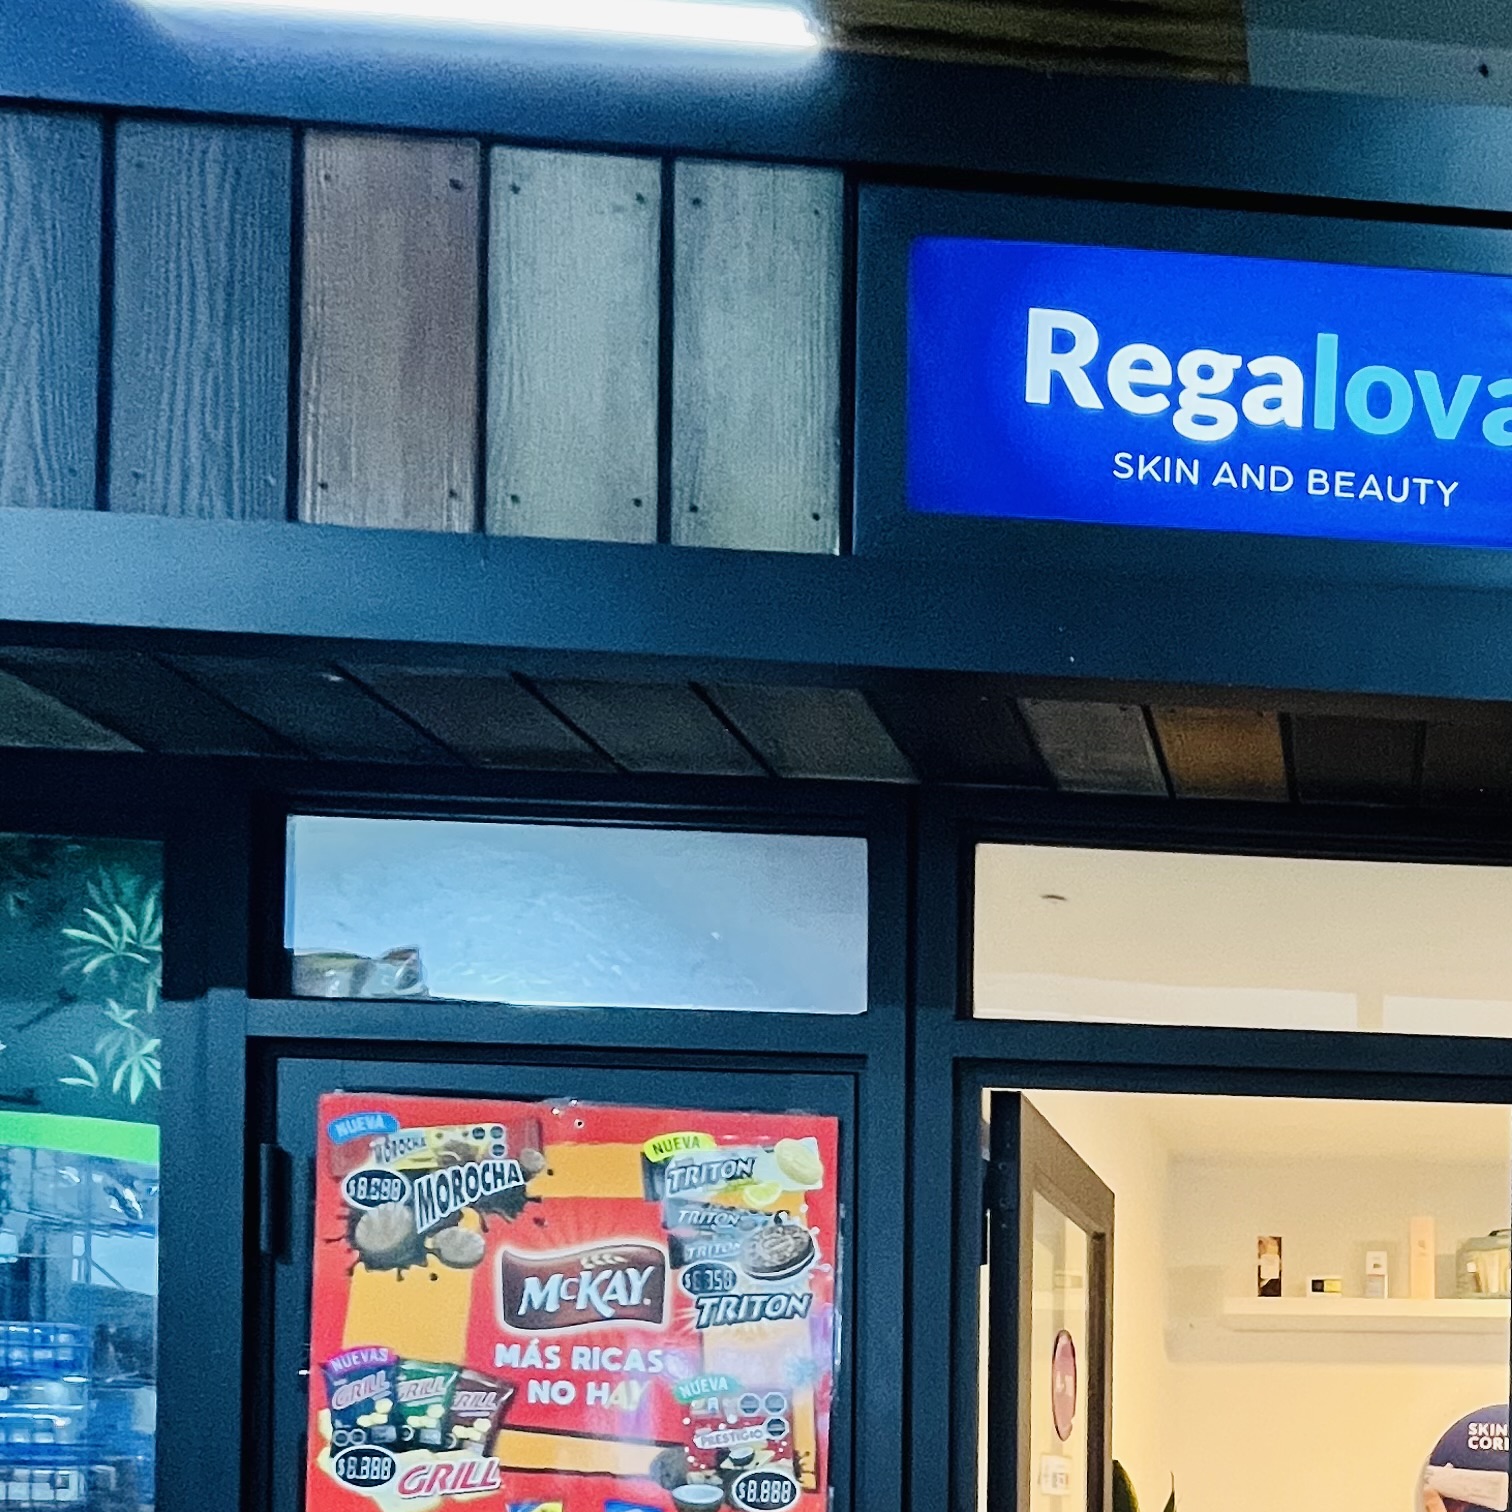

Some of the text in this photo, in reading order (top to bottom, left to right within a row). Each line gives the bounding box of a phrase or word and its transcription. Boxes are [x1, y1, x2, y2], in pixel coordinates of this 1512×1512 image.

[1112, 451, 1460, 508] SKIN AND BEAUTY
[336, 1114, 385, 1138] NUEVA
[652, 1135, 701, 1155] NUEVA
[668, 1156, 757, 1193] TRITON
[415, 1160, 525, 1234] MOROCHA
[696, 1292, 813, 1329] TRITON
[331, 1347, 389, 1372] NUEVAS
[495, 1338, 664, 1374] MÁS RICAS
[332, 1370, 391, 1409] GRILL
[527, 1379, 651, 1412] NO HAY
[679, 1377, 729, 1398] NUEVA
[700, 1428, 764, 1447] PRESTIGIO
[398, 1456, 501, 1500] GRILL
